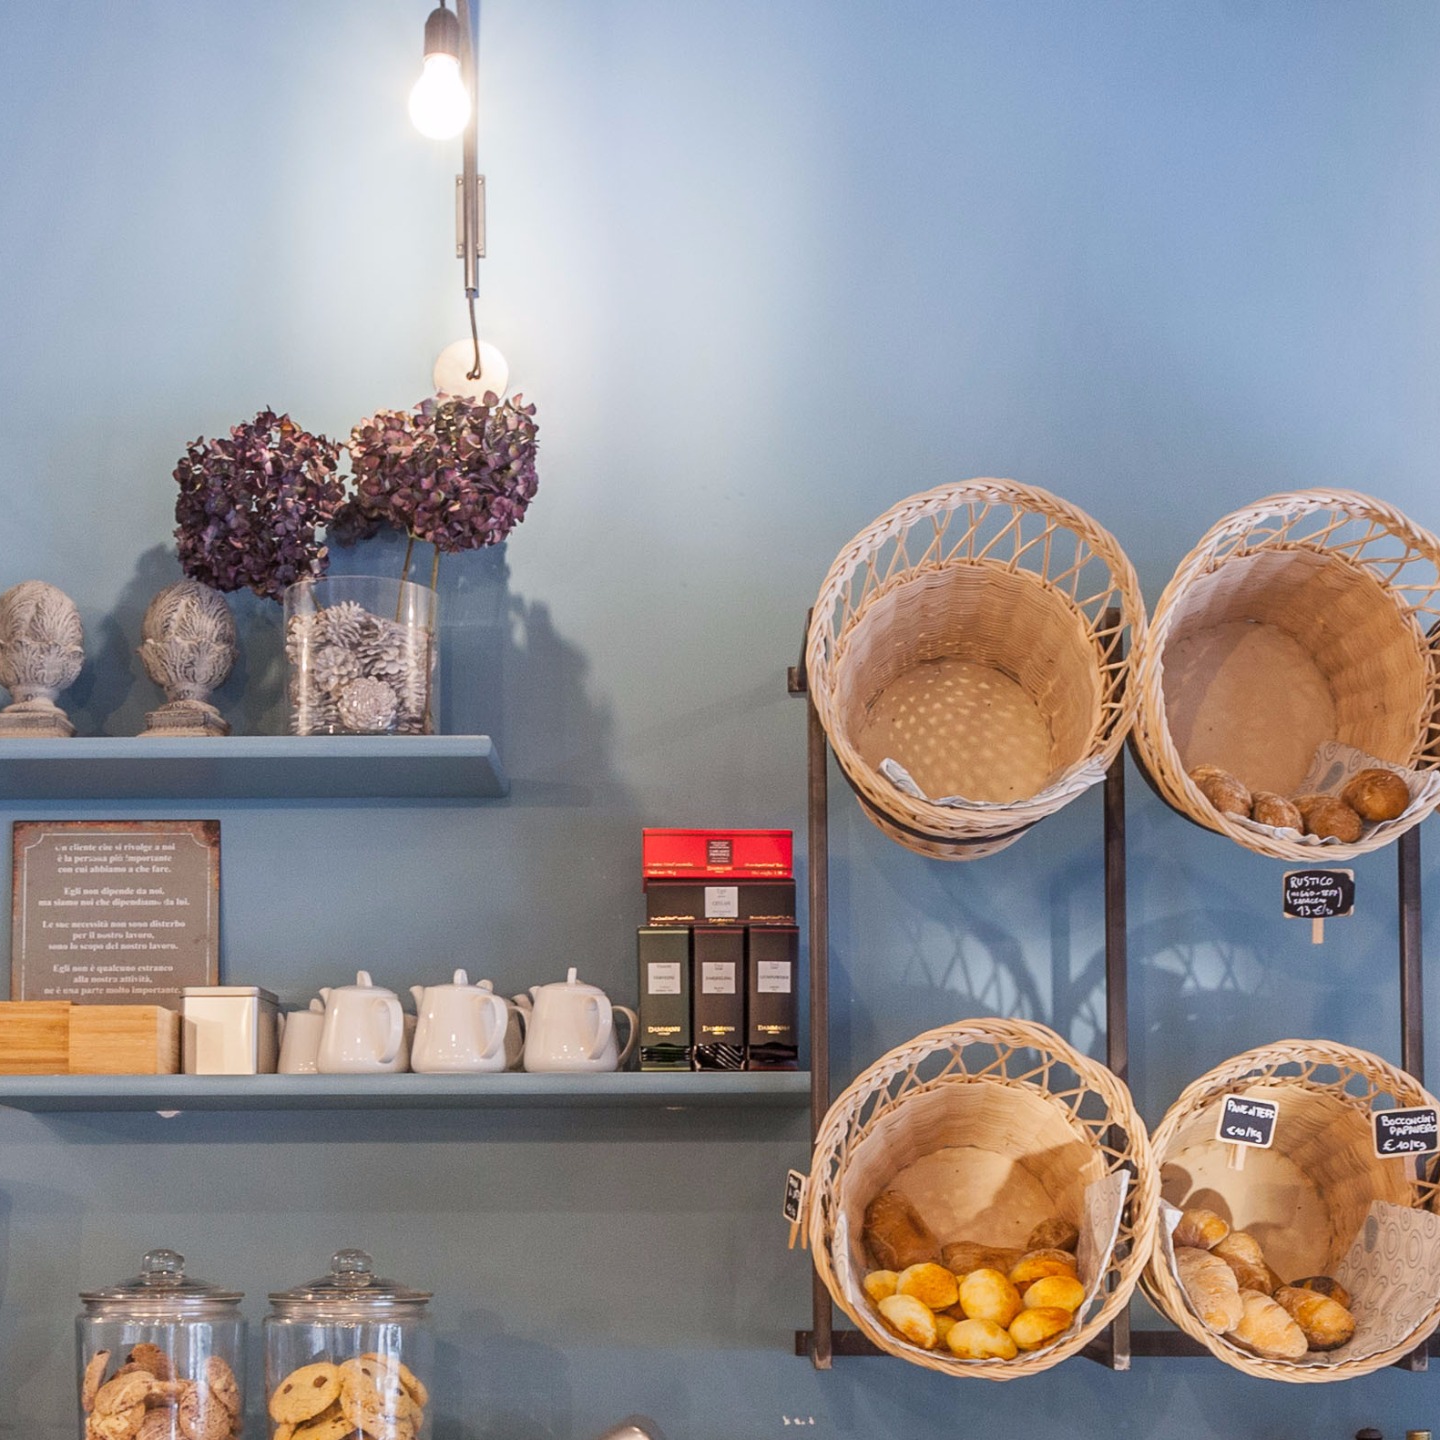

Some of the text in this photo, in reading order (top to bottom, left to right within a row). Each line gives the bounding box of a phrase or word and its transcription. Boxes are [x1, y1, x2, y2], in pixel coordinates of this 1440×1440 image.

[69, 843, 96, 851] cliente
[115, 843, 122, 851] si
[124, 843, 153, 853] rivolge
[162, 843, 176, 851] noi
[64, 854, 73, 862] la
[75, 865, 88, 873] cui
[90, 865, 127, 873] abbiamo
[135, 865, 150, 873] che
[152, 865, 172, 873] fare.
[1290, 876, 1334, 888] RUSTICO
[64, 887, 81, 897] Egli
[101, 887, 134, 897] dipende
[136, 887, 147, 895] da
[53, 898, 78, 906] siamo
[80, 898, 94, 906] noi
[95, 898, 110, 906] che
[176, 898, 190, 906] lui.
[1297, 905, 1311, 916] 13
[42, 920, 55, 928] Le
[71, 920, 108, 928] necessità
[72, 932, 87, 941] per
[89, 931, 96, 939] il
[97, 931, 123, 939] nostro
[70, 942, 79, 950] lo
[80, 943, 104, 952] scopo
[105, 942, 119, 950] del
[120, 942, 147, 950] nostro
[53, 964, 69, 974] Egli
[97, 964, 136, 974] qualcuno
[73, 975, 89, 983] alla
[91, 975, 117, 983] nostra
[81, 987, 103, 997] parte
[105, 986, 129, 995] molto
